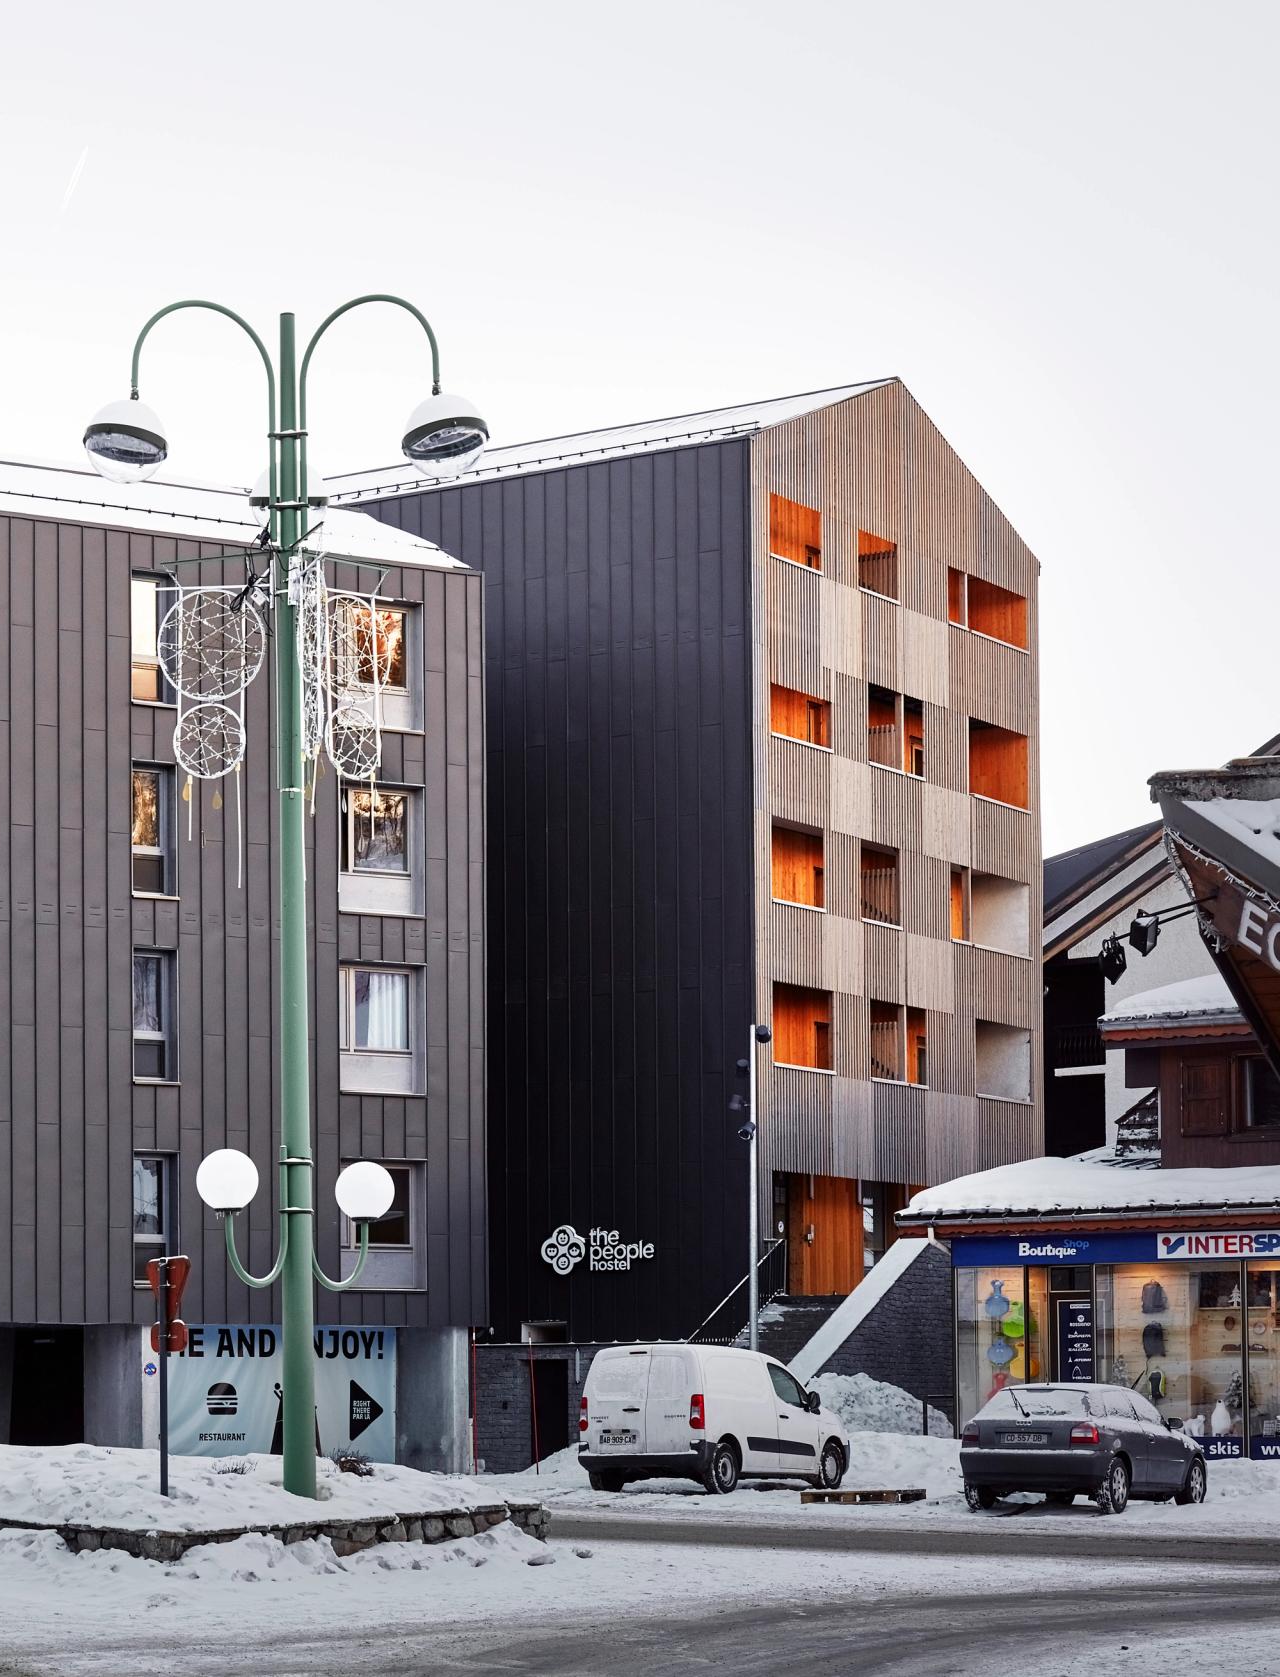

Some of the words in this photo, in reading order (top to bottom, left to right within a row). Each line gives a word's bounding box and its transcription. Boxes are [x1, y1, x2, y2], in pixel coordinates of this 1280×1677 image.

[589, 1227, 619, 1245] the
[1019, 1243, 1077, 1258] Boutique
[1063, 1239, 1089, 1250] Shop
[590, 1240, 654, 1265] people
[590, 1259, 630, 1271] hostel
[216, 1329, 275, 1357] AND
[314, 1329, 384, 1359] NJOY!
[199, 1433, 245, 1441] RESTAURANT
[1209, 1442, 1240, 1455] skis
